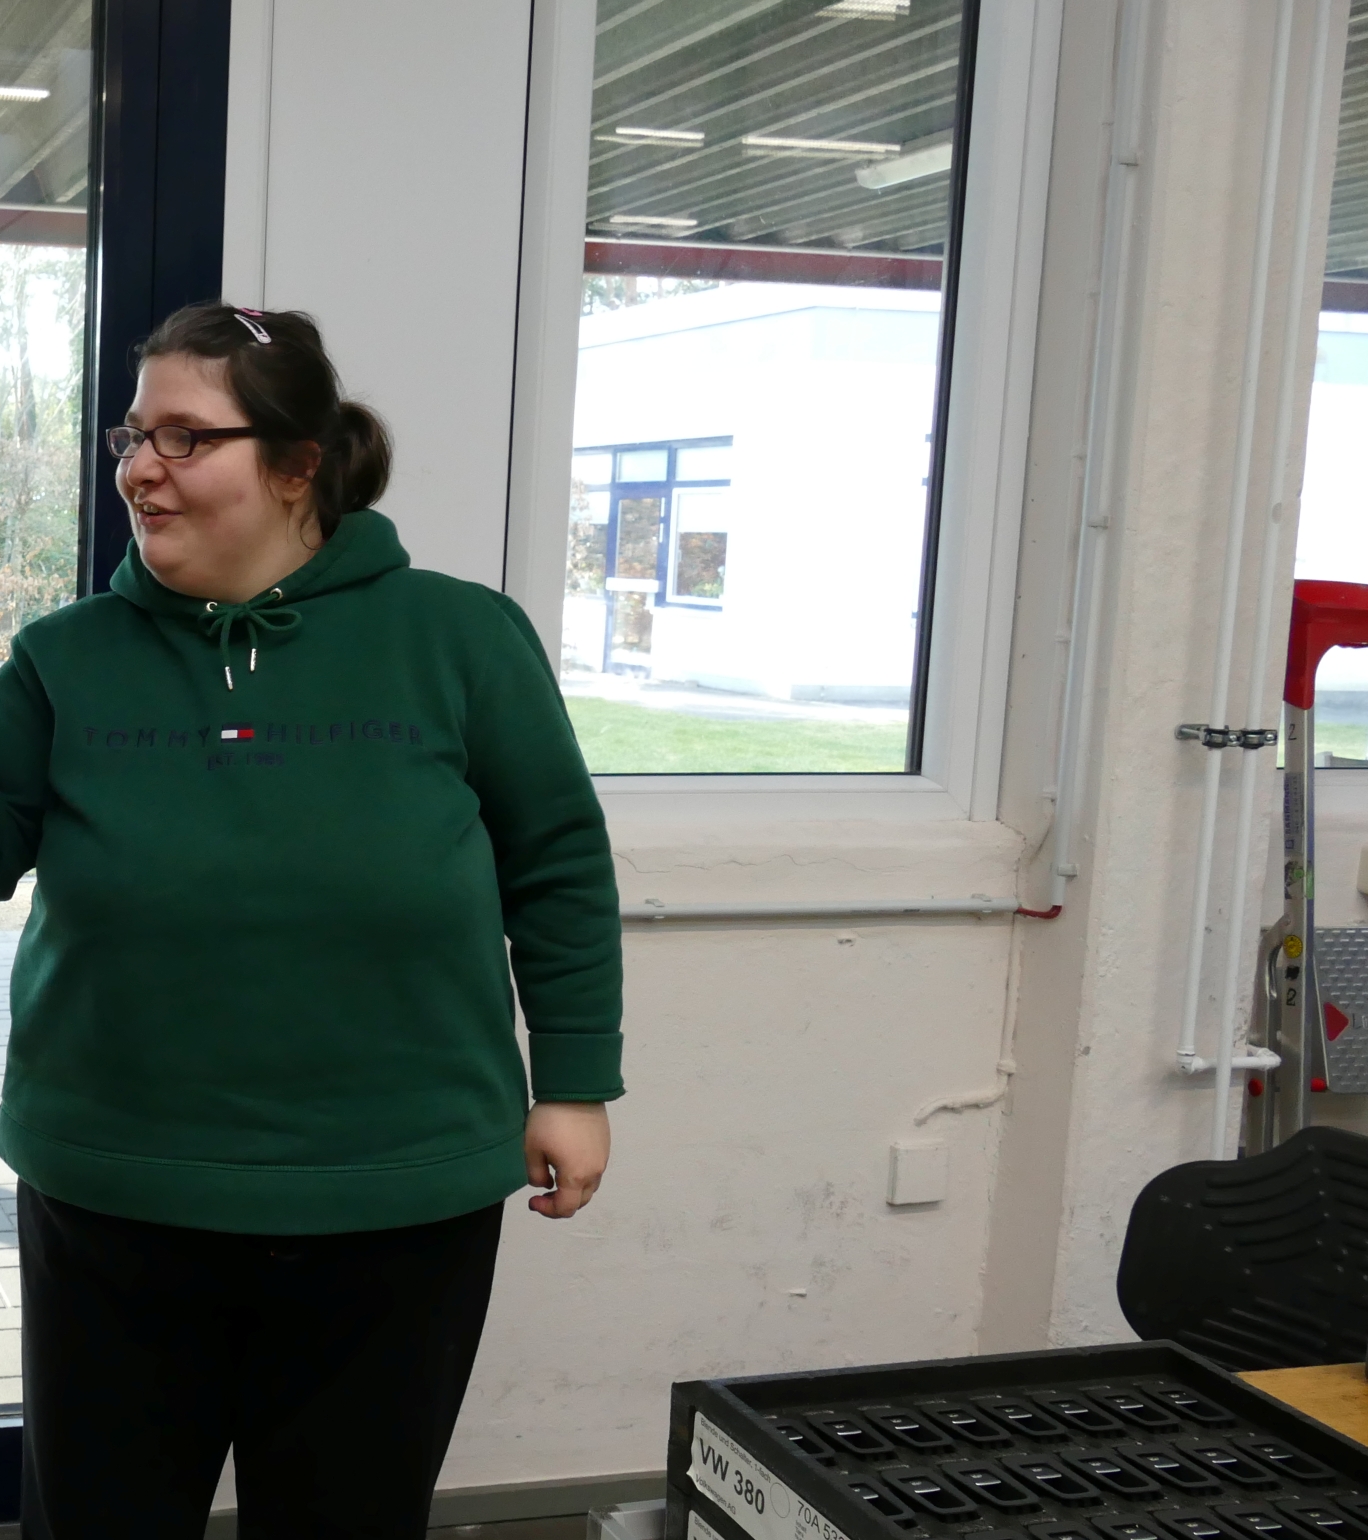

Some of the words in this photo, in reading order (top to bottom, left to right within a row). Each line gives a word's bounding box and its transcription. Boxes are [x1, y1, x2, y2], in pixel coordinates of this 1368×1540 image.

[83, 724, 211, 748] TOMMY
[266, 719, 423, 746] HILFIGER
[700, 1437, 729, 1482] VW
[734, 1469, 764, 1515] 380
[797, 1500, 820, 1533] 70A
[823, 1522, 845, 1540] 53
